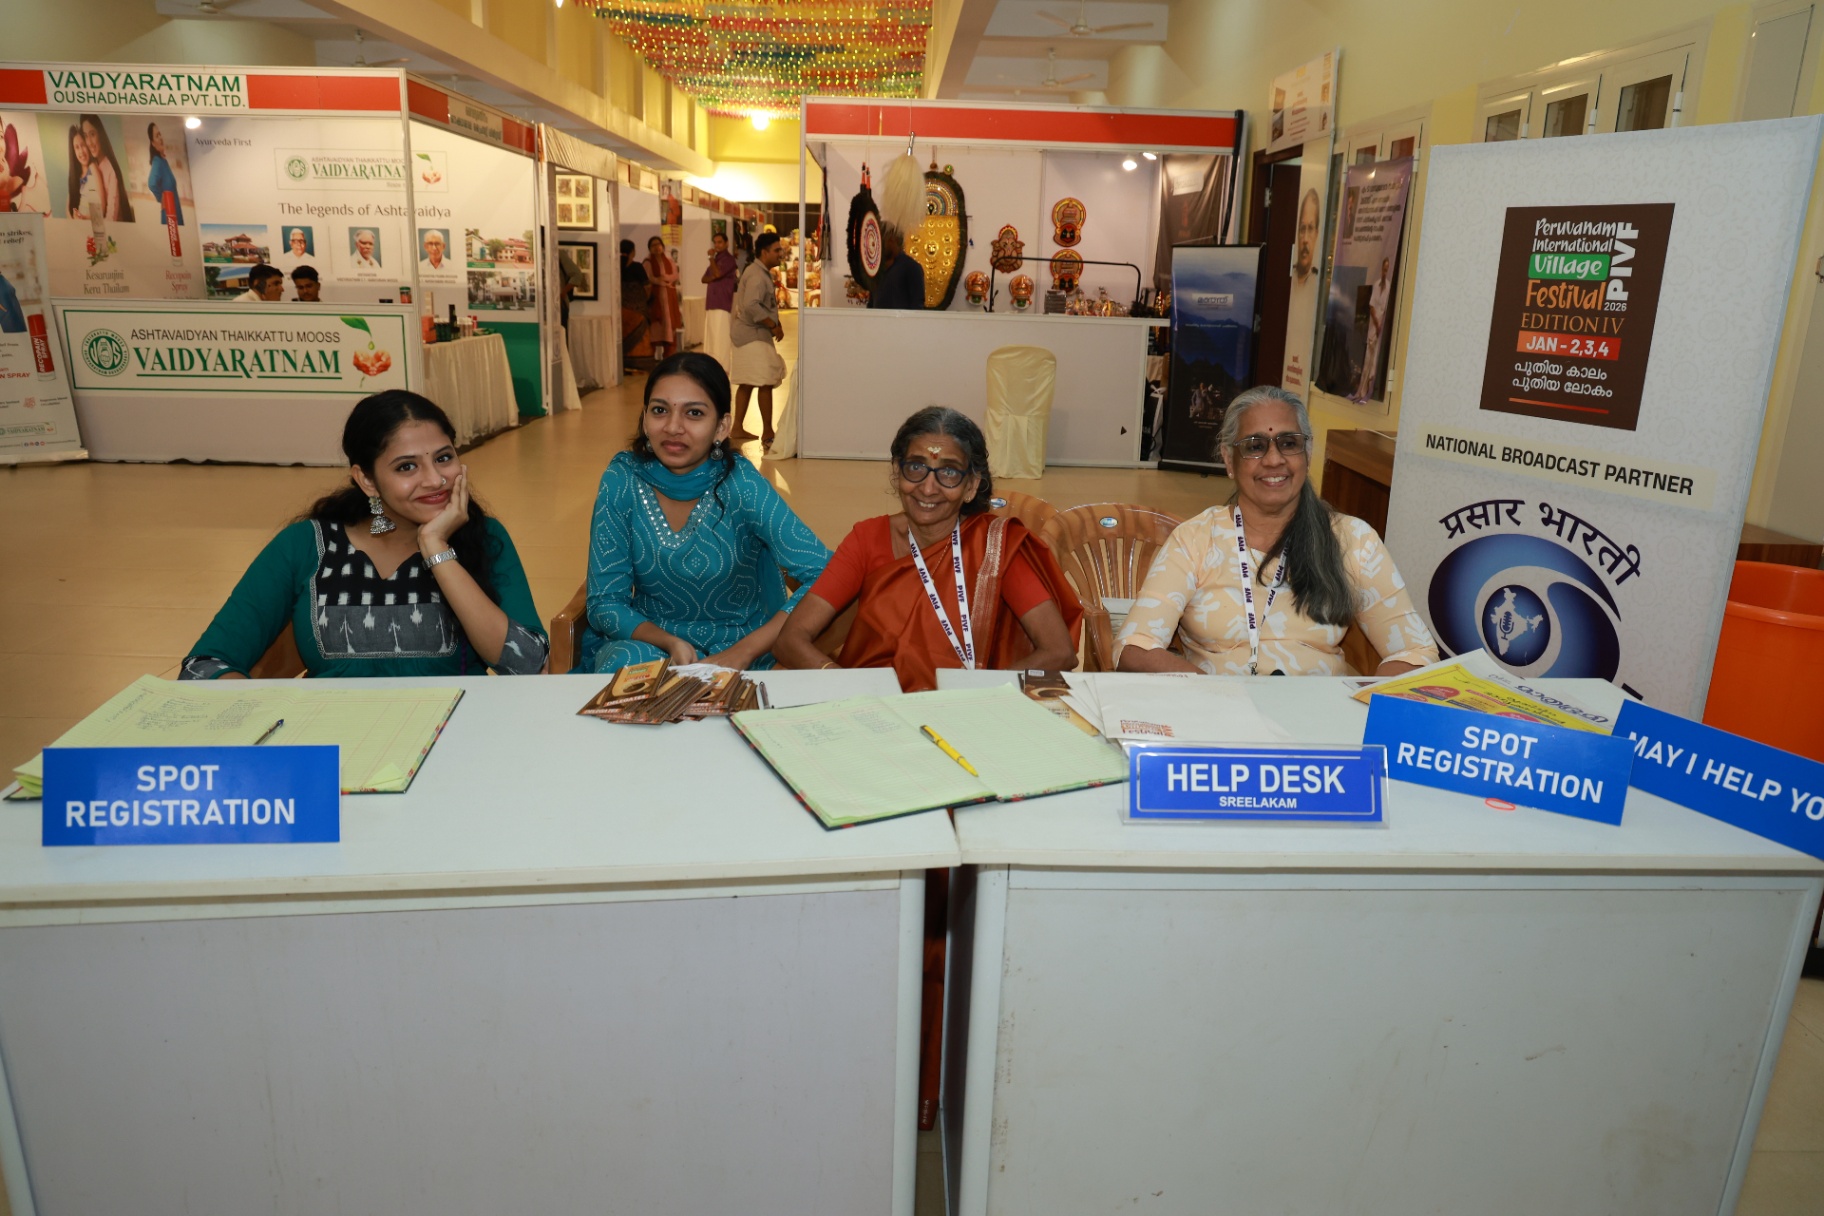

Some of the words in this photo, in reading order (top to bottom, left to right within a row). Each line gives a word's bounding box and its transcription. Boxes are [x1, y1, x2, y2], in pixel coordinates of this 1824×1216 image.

[48, 71, 241, 92] VAIDYARATNAM
[54, 90, 177, 106] OUSHADHASALA
[195, 137, 231, 147] Ayurveda
[233, 138, 251, 147] First
[278, 203, 303, 215] The
[306, 203, 354, 218] legends
[358, 203, 372, 215] of
[374, 204, 451, 218] Ashtaaidya
[1534, 217, 1616, 237] Peruvanam
[1532, 237, 1613, 253] International
[1534, 254, 1603, 279] Village
[1605, 222, 1640, 302] PIVF
[1525, 279, 1607, 311] Festival
[1604, 302, 1627, 312] 2026
[1520, 313, 1599, 334] EDITION
[1602, 316, 1626, 335] IV
[130, 328, 218, 342] ASHTAVAIDYAN
[220, 330, 293, 343] THAIKKATTU
[296, 330, 341, 343] MOOSS
[1525, 336, 1558, 352] JAN
[1570, 339, 1609, 358] 2,3,4
[133, 347, 341, 378] VAIDYARATNAM
[1514, 359, 1563, 376] പുതിയ
[1566, 366, 1607, 380] കാലം
[1512, 375, 1561, 392] പുതിയ
[1564, 381, 1612, 397] ലോകം
[1425, 433, 1497, 460] NATIONAL
[1501, 446, 1601, 479] BROADCAST
[1604, 464, 1694, 496] PARTNER
[1237, 536, 1246, 552] PIVF
[1439, 499, 1525, 539] प्रसार
[1538, 502, 1641, 586] भारती
[953, 556, 961, 573] PIVF
[1240, 562, 1249, 578] PIVF
[918, 567, 930, 584] PIVF
[929, 593, 940, 610] PIVF
[957, 585, 965, 603] PIVF
[1244, 587, 1253, 603] PIVF
[941, 619, 952, 637] PIVF
[961, 614, 969, 632] PIVF
[1247, 612, 1257, 630] PIVF
[965, 643, 974, 661] PIVF
[1461, 726, 1539, 759] SPOT
[136, 764, 220, 792] SPOT
[1167, 763, 1250, 793] HELP
[1260, 765, 1346, 794] DESK
[1396, 742, 1604, 804] REGISTRATION
[1627, 731, 1686, 769] MAY
[1686, 752, 1698, 775] I
[1702, 758, 1783, 802] HELP
[1791, 787, 1824, 822] YO
[1218, 795, 1297, 810] SREELAKAM
[65, 798, 295, 828] REGISTRATION
